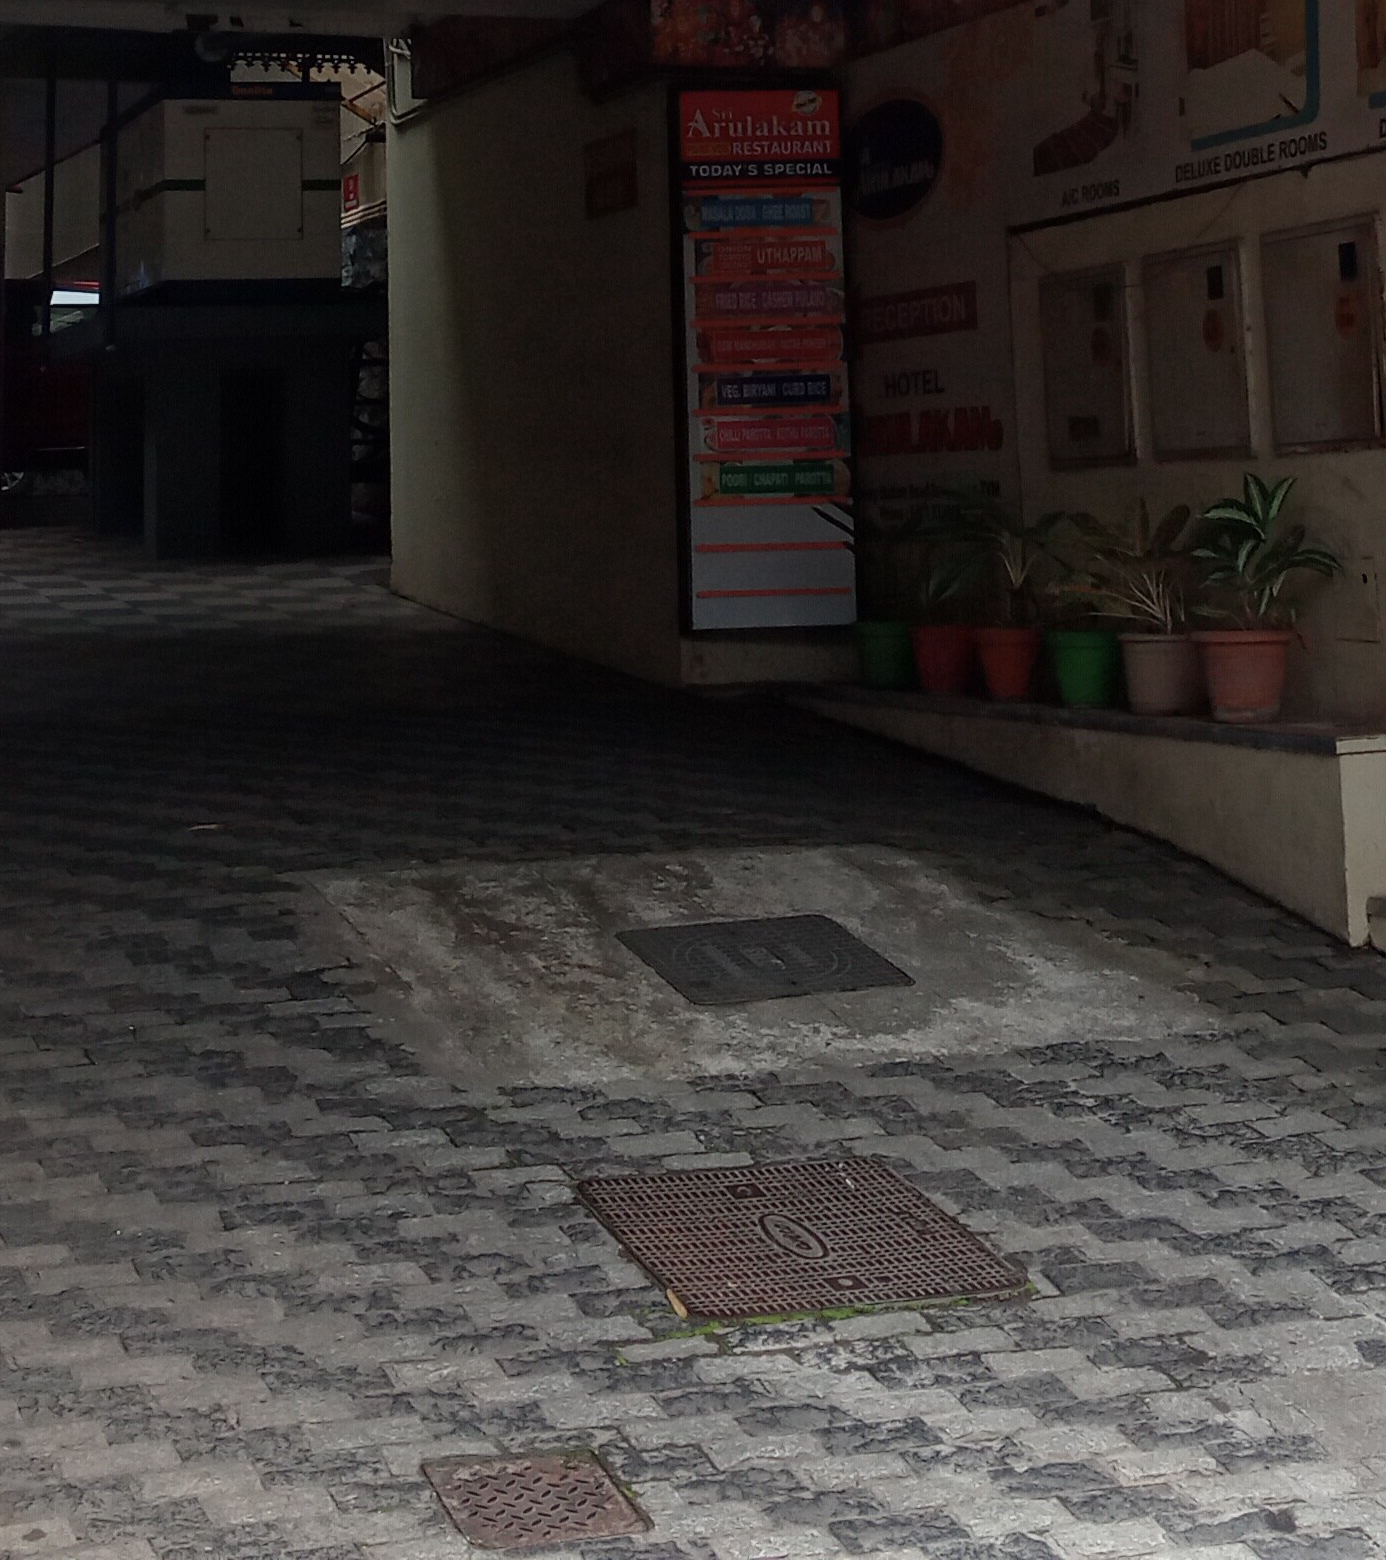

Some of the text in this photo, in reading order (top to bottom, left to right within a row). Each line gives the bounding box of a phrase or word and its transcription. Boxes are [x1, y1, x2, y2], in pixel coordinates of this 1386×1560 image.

[687, 108, 830, 137] Arulakam
[733, 141, 831, 155] RESTAURANT
[1175, 132, 1327, 183] DELUXE DOUBLE ROOMS
[689, 163, 833, 177] TODAY'S SPECIAL
[757, 246, 821, 264] UTHAPPAM
[885, 369, 945, 397] HOTEL
